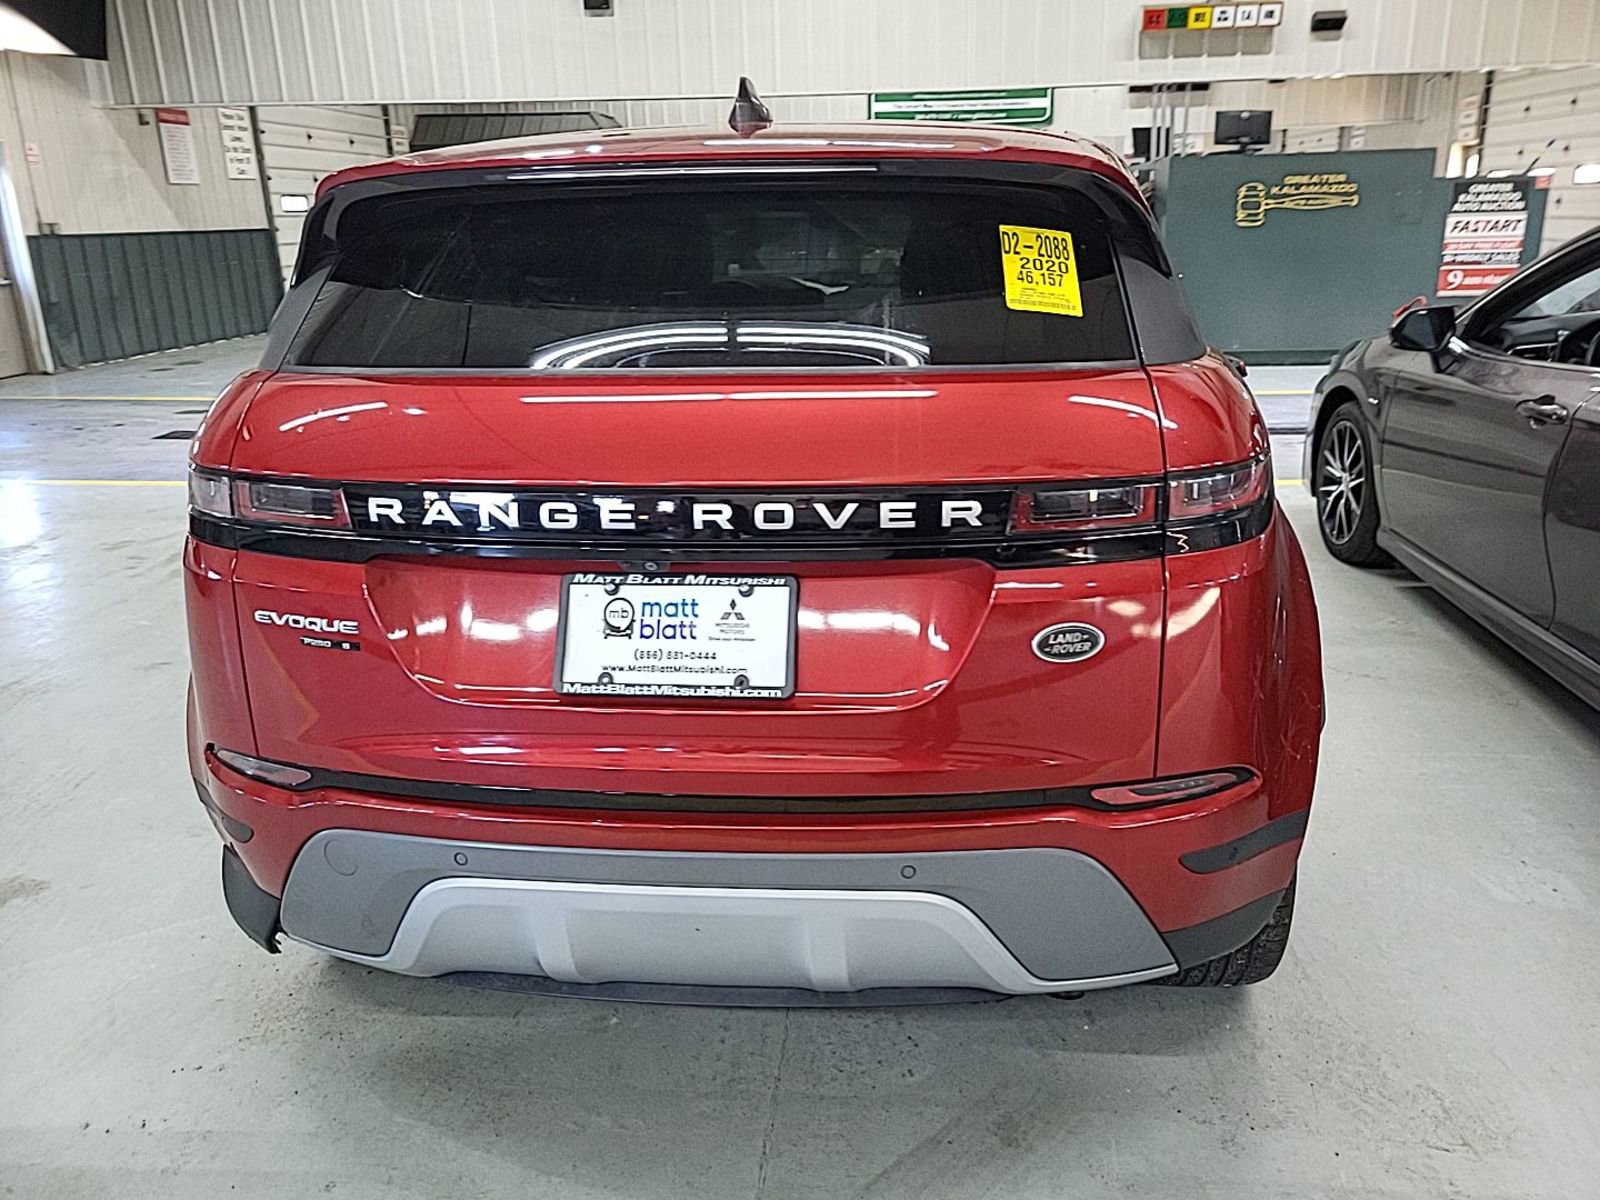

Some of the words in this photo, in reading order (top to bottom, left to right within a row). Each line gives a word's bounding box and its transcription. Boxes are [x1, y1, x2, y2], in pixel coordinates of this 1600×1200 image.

[1450, 218, 1524, 234] FASTART
[1002, 231, 1069, 260] D2-2088
[1019, 257, 1069, 274] 2020
[1446, 269, 1464, 290] 9
[366, 497, 637, 530] RANGE
[692, 500, 983, 530] ROVER
[572, 573, 625, 584] MATT
[626, 573, 682, 585] BLATT
[683, 574, 786, 586] MITSUBISHI
[609, 607, 629, 619] mb
[641, 598, 699, 618] matt
[254, 609, 359, 634] EVOQUE
[639, 618, 697, 640] blatt
[562, 682, 783, 698] MattBlattMitsubishi.com
